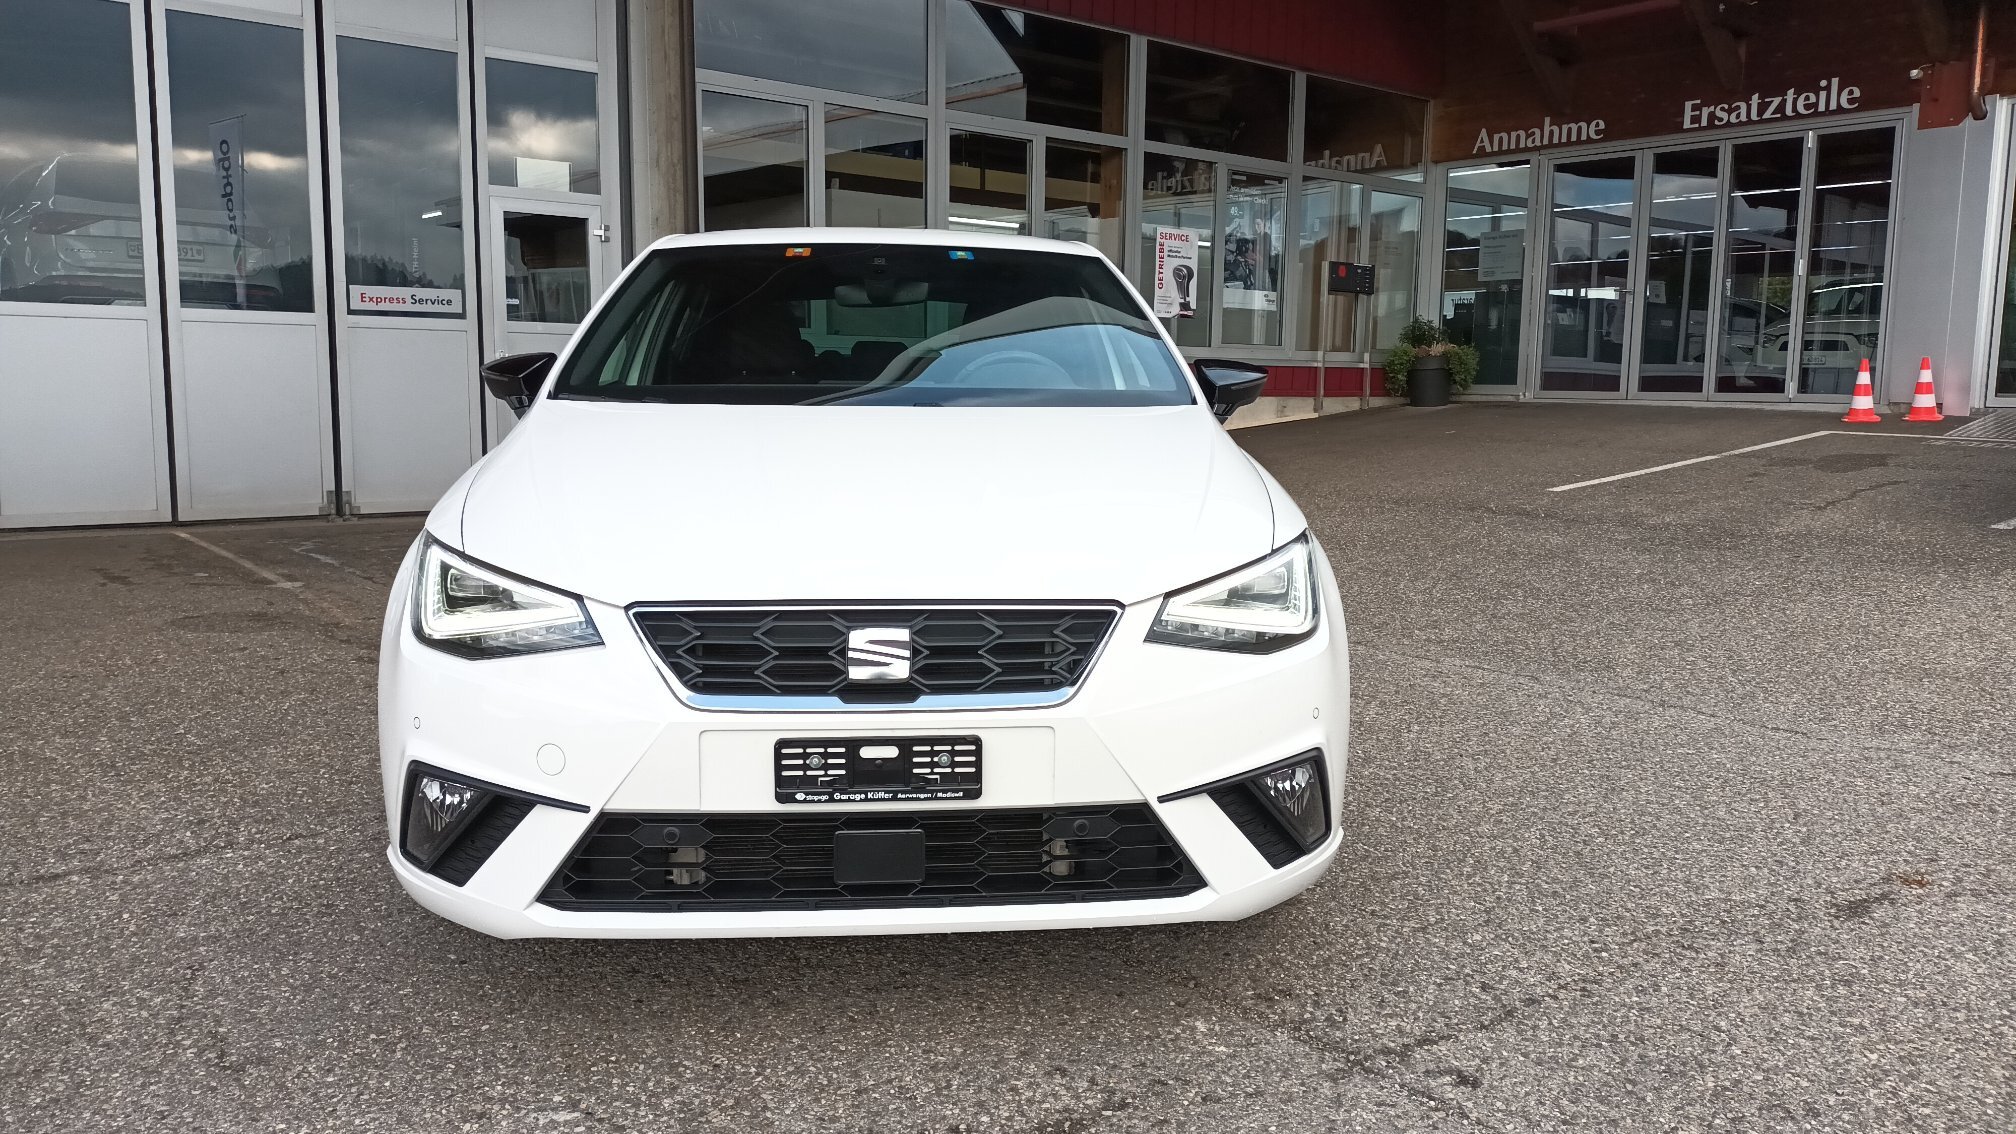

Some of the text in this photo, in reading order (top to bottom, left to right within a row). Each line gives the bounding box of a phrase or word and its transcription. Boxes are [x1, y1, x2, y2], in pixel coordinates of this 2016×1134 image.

[1682, 77, 1861, 129] Ersatzteile
[1472, 116, 1605, 154] Annahme
[1159, 231, 1190, 242] SERVICE
[1157, 241, 1165, 290] GETRIEBE
[360, 292, 453, 306] Express Service
[833, 792, 866, 801] Garage
[867, 791, 894, 799] Küffer
